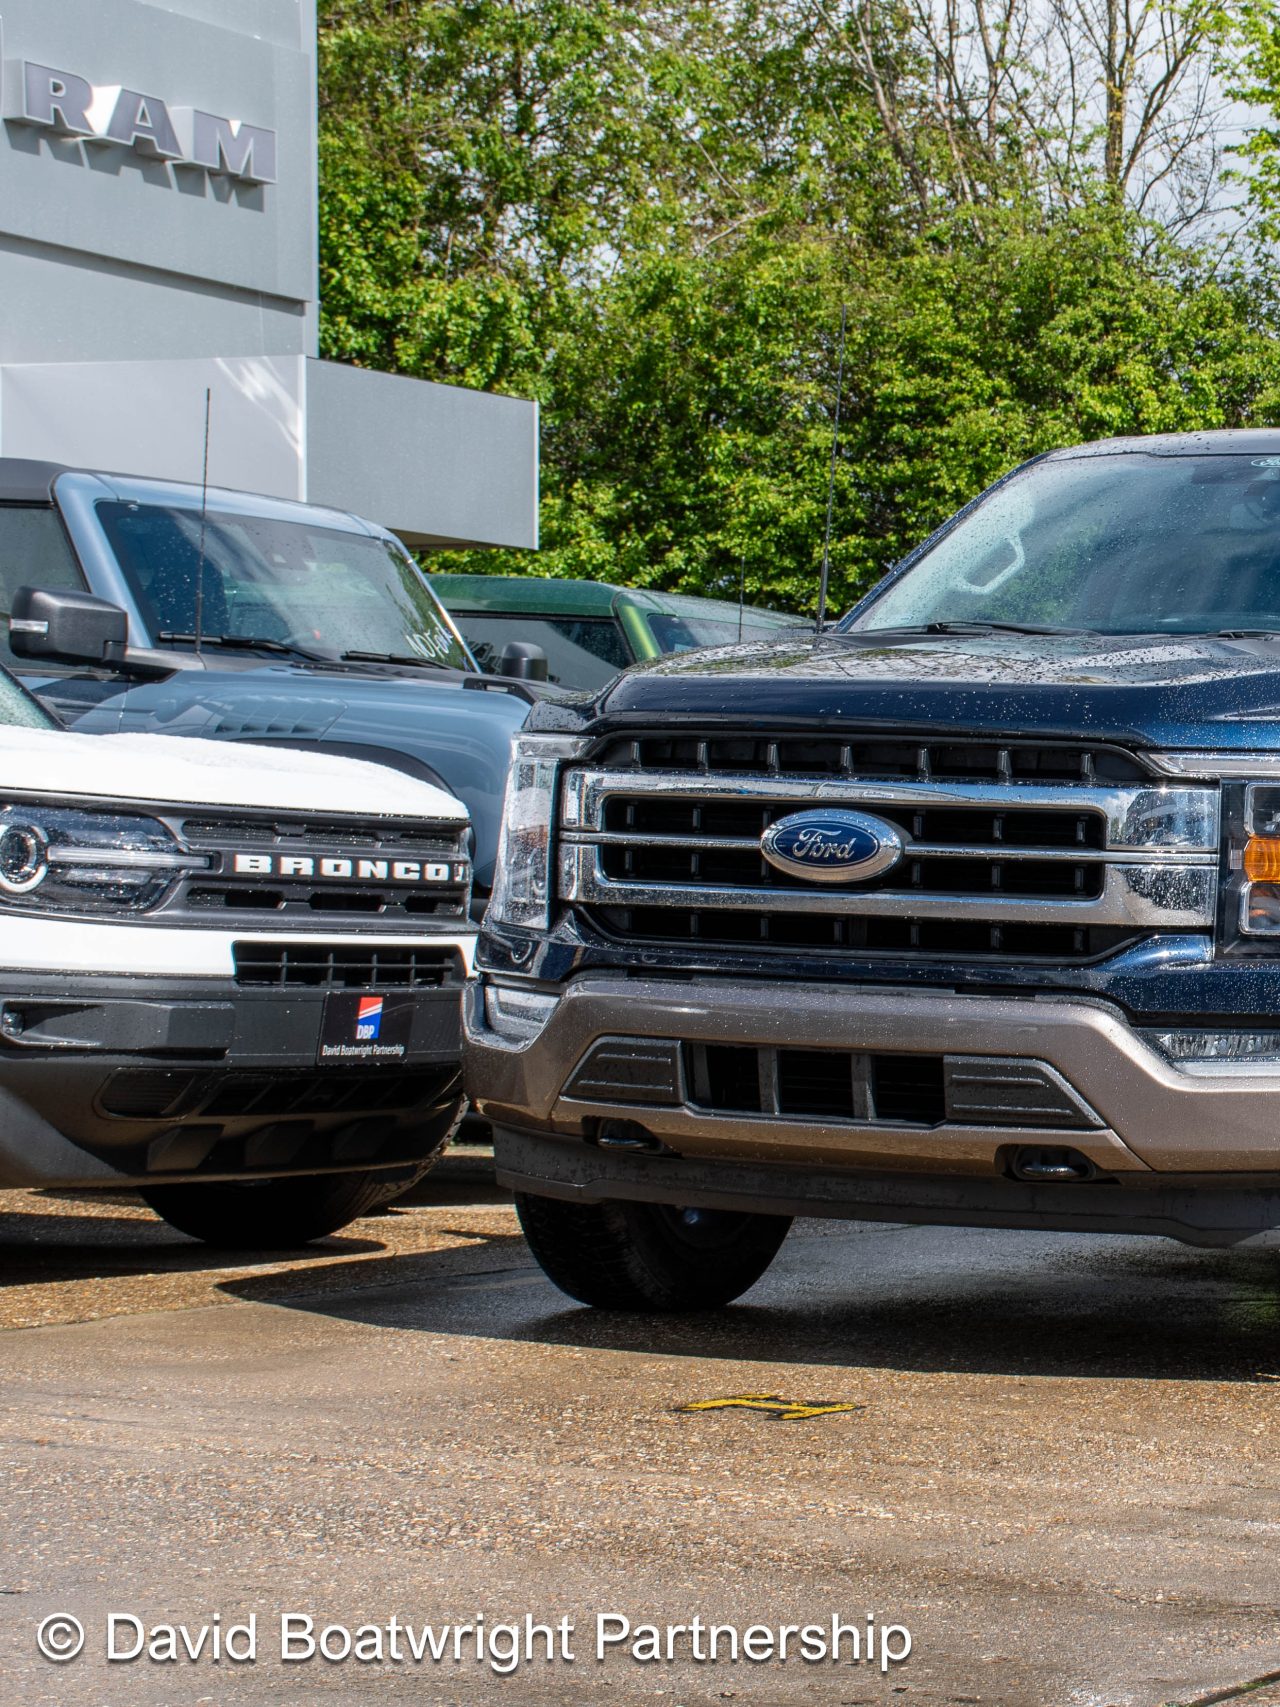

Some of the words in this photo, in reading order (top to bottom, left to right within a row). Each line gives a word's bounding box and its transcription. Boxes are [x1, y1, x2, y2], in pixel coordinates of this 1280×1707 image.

[20, 59, 277, 184] RAM
[793, 828, 857, 859] Ford
[235, 854, 450, 881] BRONCO
[357, 1025, 375, 1039] DBP
[322, 1045, 340, 1056] David
[341, 1045, 372, 1058] Boatwright
[373, 1043, 404, 1057] Partnership
